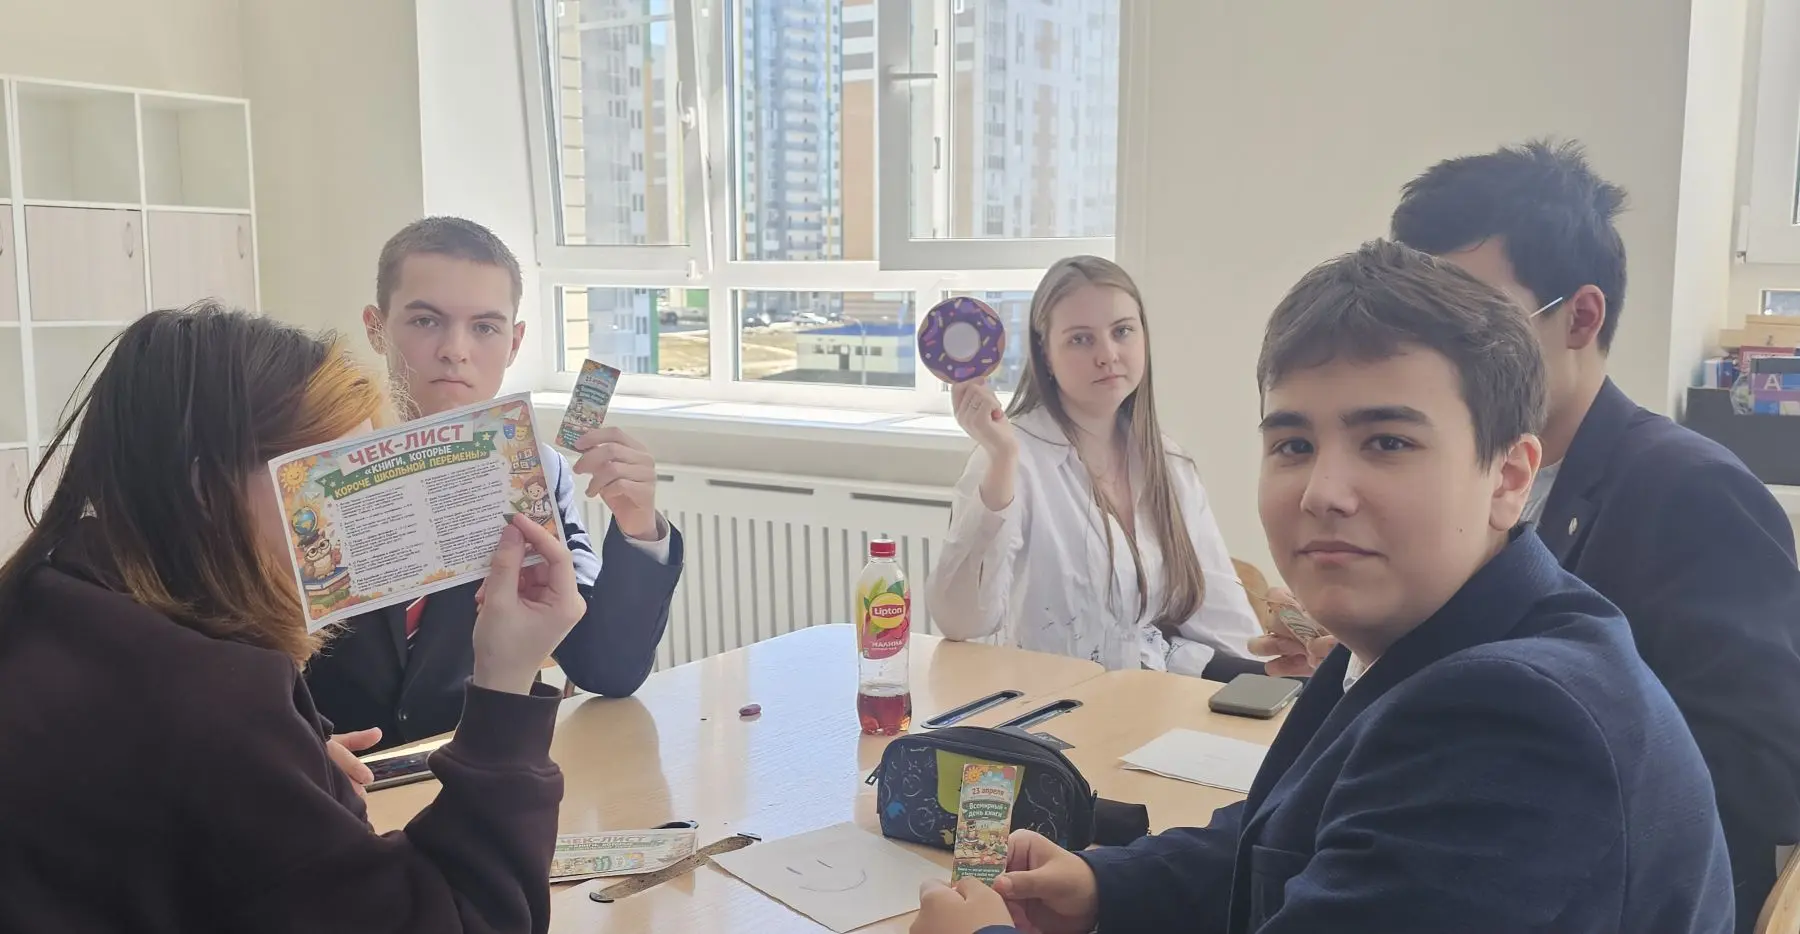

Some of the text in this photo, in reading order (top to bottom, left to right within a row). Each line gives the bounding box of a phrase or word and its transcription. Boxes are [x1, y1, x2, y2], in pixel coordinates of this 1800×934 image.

[348, 424, 464, 467] ЧЕК-ЛИСТ
[409, 445, 452, 461] КОТОРЫЕ
[334, 449, 488, 499] КОРОЧЕ ШКОЛЬНОЙ ПЕРЕМЕНЫ»
[874, 608, 902, 617] Lipton
[972, 787, 1005, 797] 23 апреля
[969, 802, 1004, 810] Всемирный
[968, 810, 1003, 818] день книги
